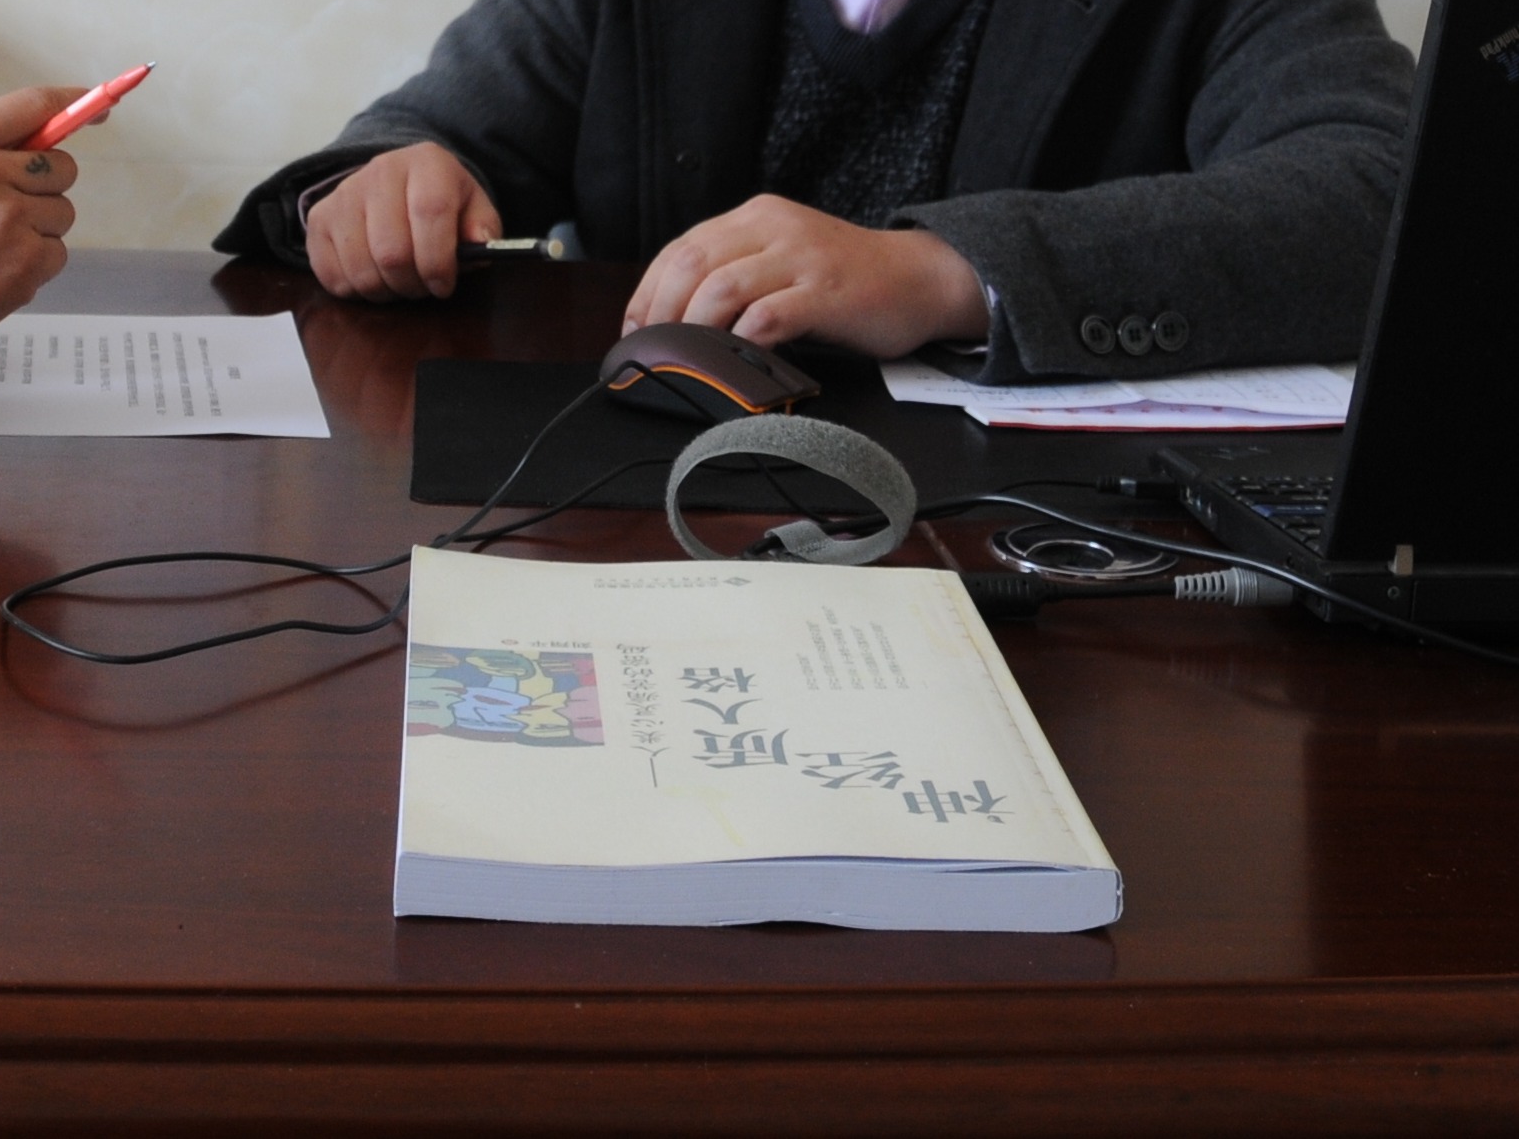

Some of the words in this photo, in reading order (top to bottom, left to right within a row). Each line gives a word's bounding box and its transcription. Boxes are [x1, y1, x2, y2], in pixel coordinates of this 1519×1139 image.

[676, 667, 1016, 824] 神经质人格
